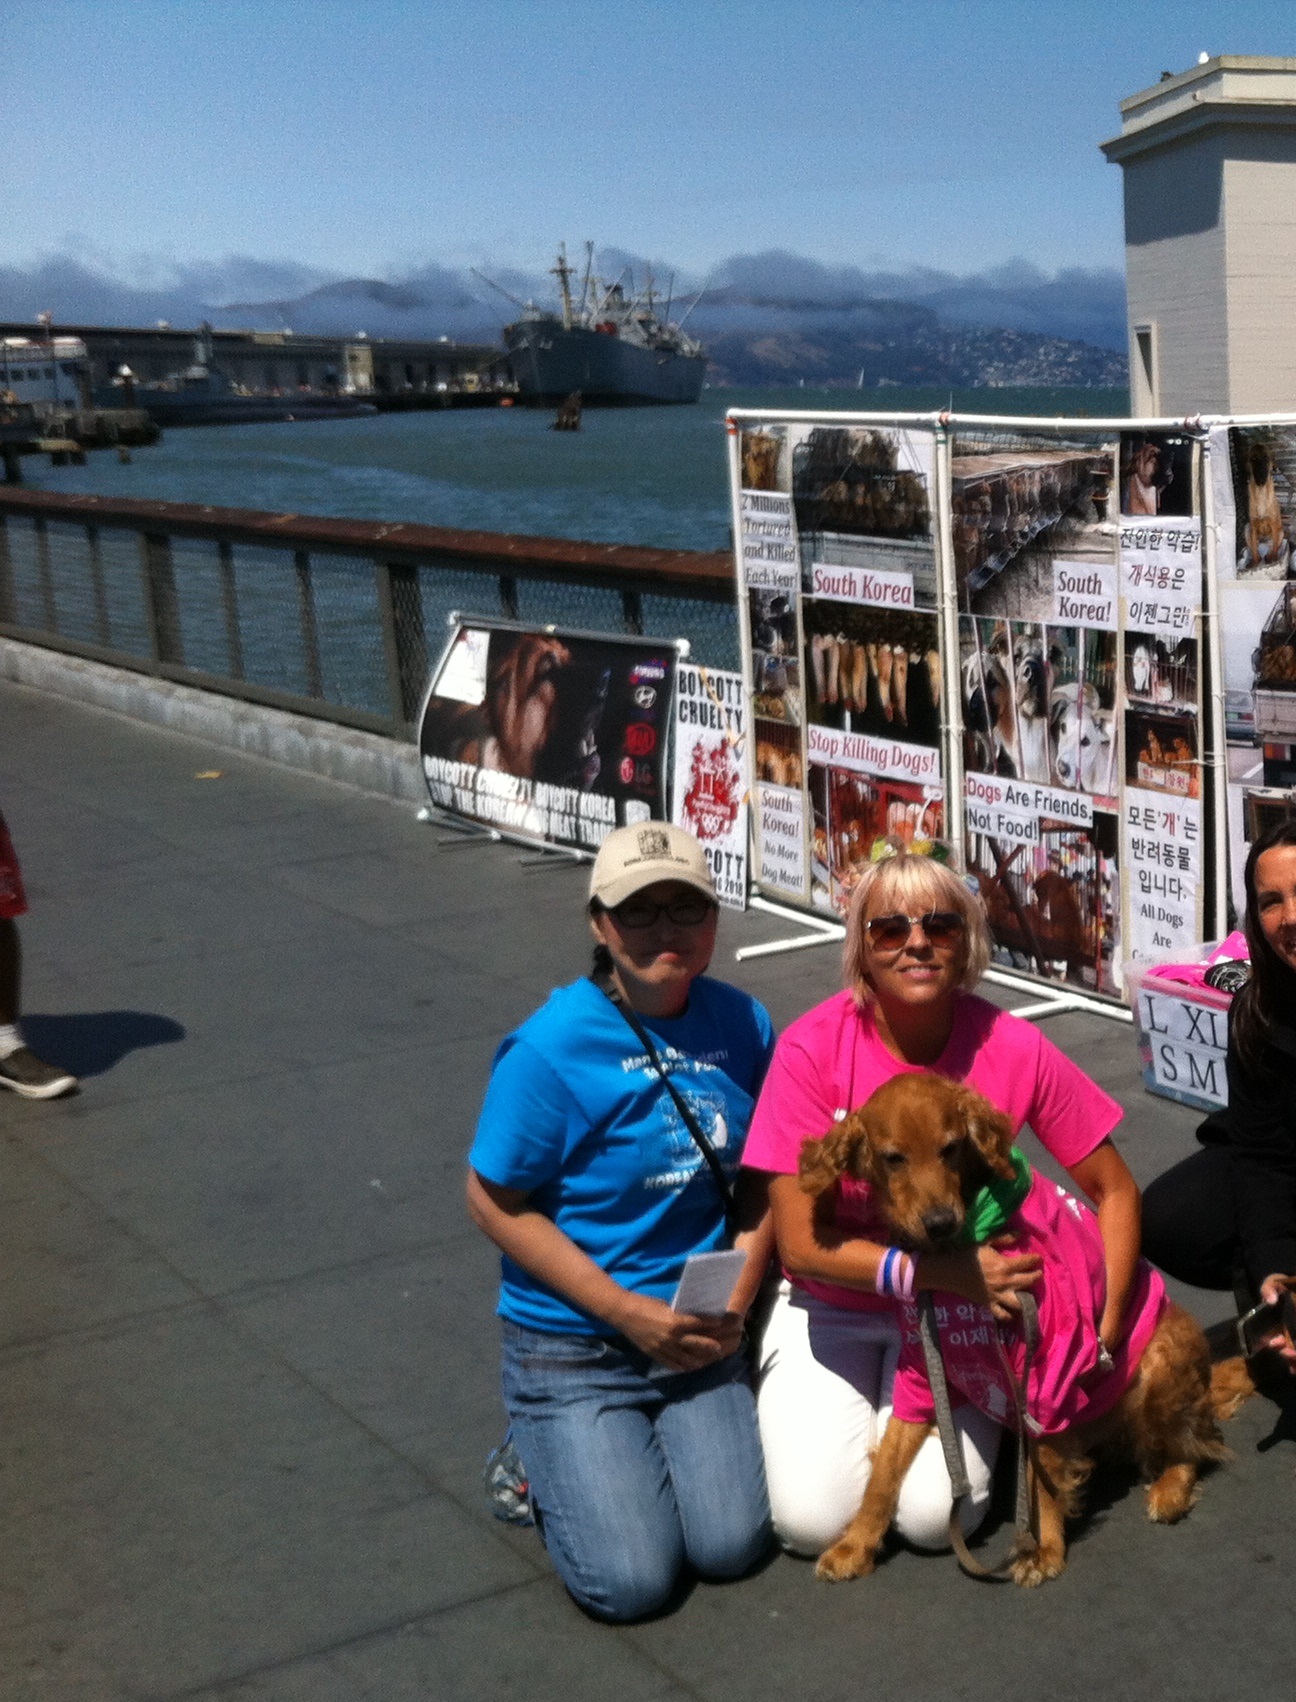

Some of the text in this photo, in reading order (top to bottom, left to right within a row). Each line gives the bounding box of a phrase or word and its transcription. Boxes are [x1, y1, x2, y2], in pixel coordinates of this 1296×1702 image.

[751, 495, 790, 513] Millions
[767, 543, 796, 561] Killed
[747, 568, 770, 583] Each
[814, 569, 912, 604] South Korea
[1058, 570, 1102, 596] South
[1059, 596, 1111, 623] Korea!
[679, 670, 743, 704] BOYCOTT
[679, 701, 743, 731] CRUELTY
[809, 729, 936, 776] Stop Killing Dogs!
[761, 791, 793, 813] South
[968, 778, 1093, 821] Dogs Are Friends.
[762, 813, 800, 838] Korea!
[969, 808, 1038, 840] Not Food!
[764, 839, 799, 862] No More
[1132, 838, 1191, 871] 반려동물
[762, 862, 803, 886] Dog Meat!
[1139, 870, 1187, 901] 입니다.
[1140, 904, 1184, 929] All Dogs
[1152, 931, 1172, 949] Are
[1144, 995, 1168, 1034] L
[1160, 1044, 1221, 1096] S M
